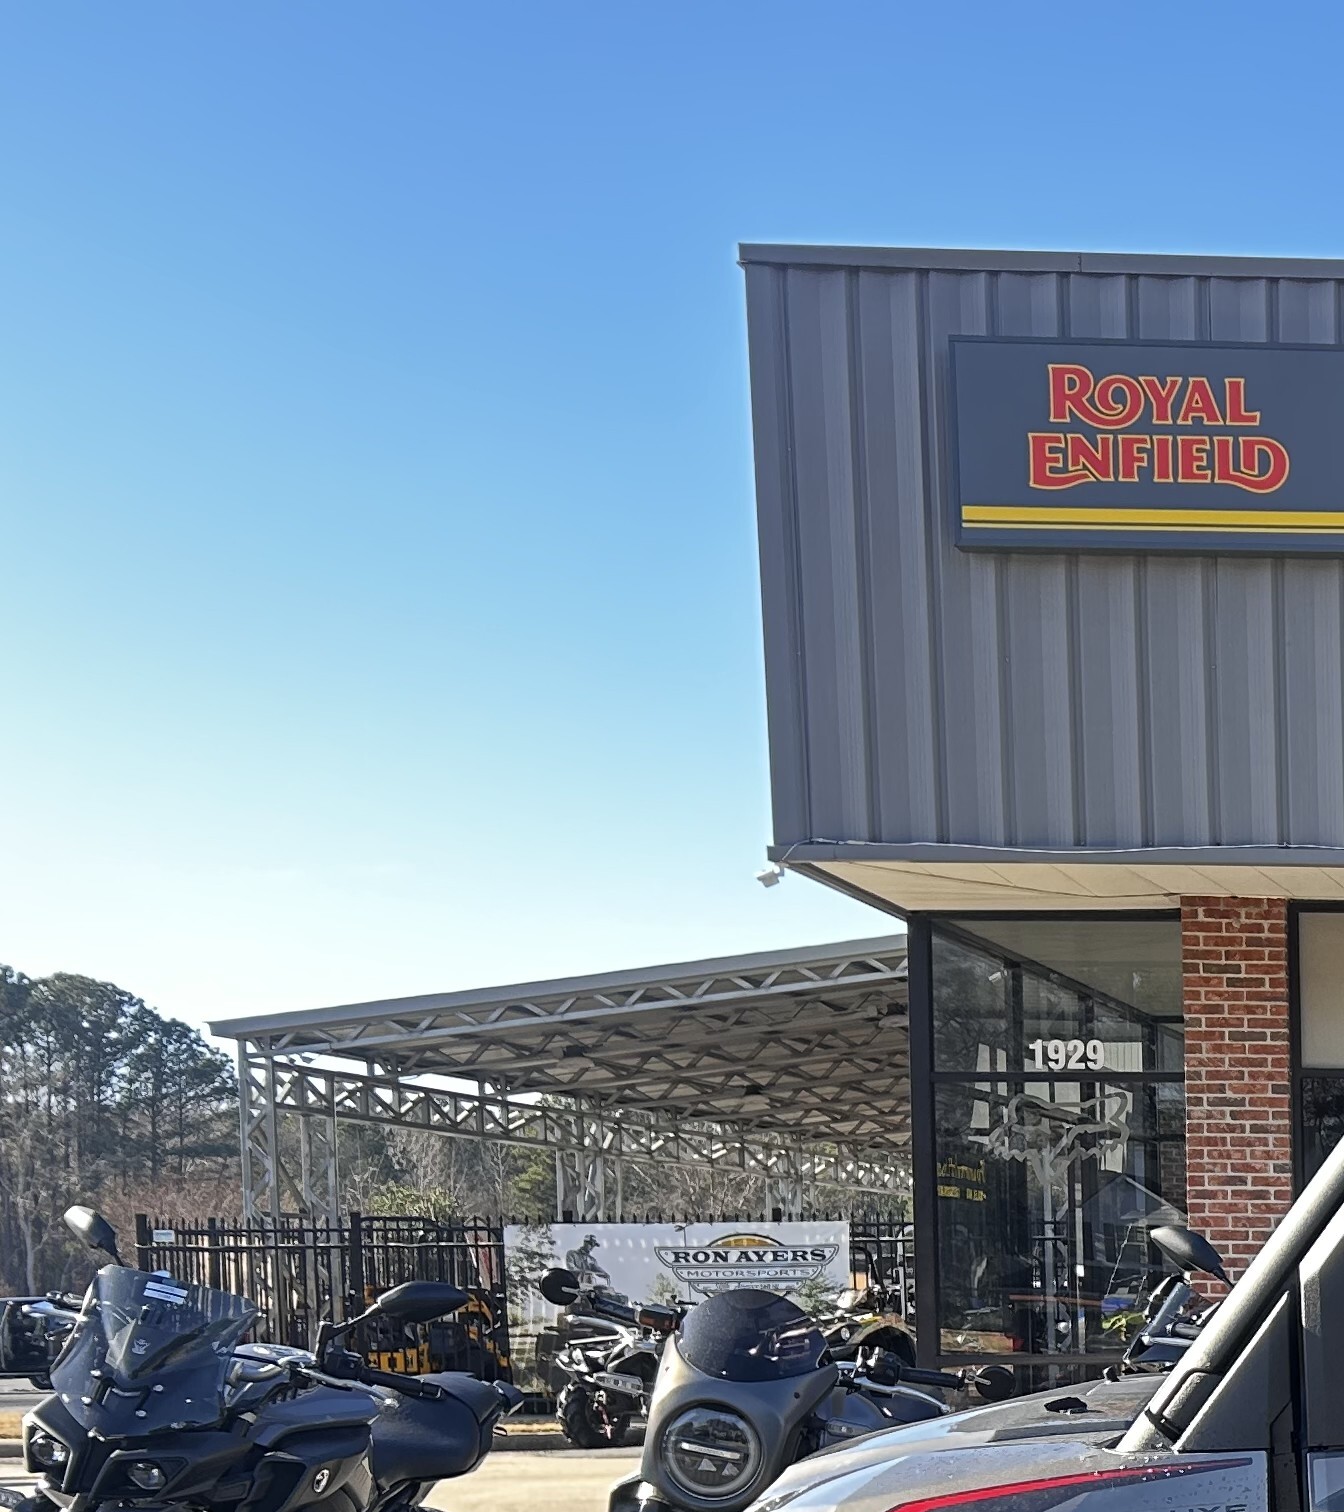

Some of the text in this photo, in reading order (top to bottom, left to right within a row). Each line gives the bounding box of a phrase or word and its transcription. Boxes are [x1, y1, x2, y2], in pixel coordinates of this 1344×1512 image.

[1047, 363, 1260, 429] ROYAL
[1028, 431, 1290, 493] ENFIELD
[1028, 1038, 1104, 1070] 1929
[671, 1248, 827, 1264] RON AYERS
[686, 1268, 811, 1278] MOTORSPORTS
